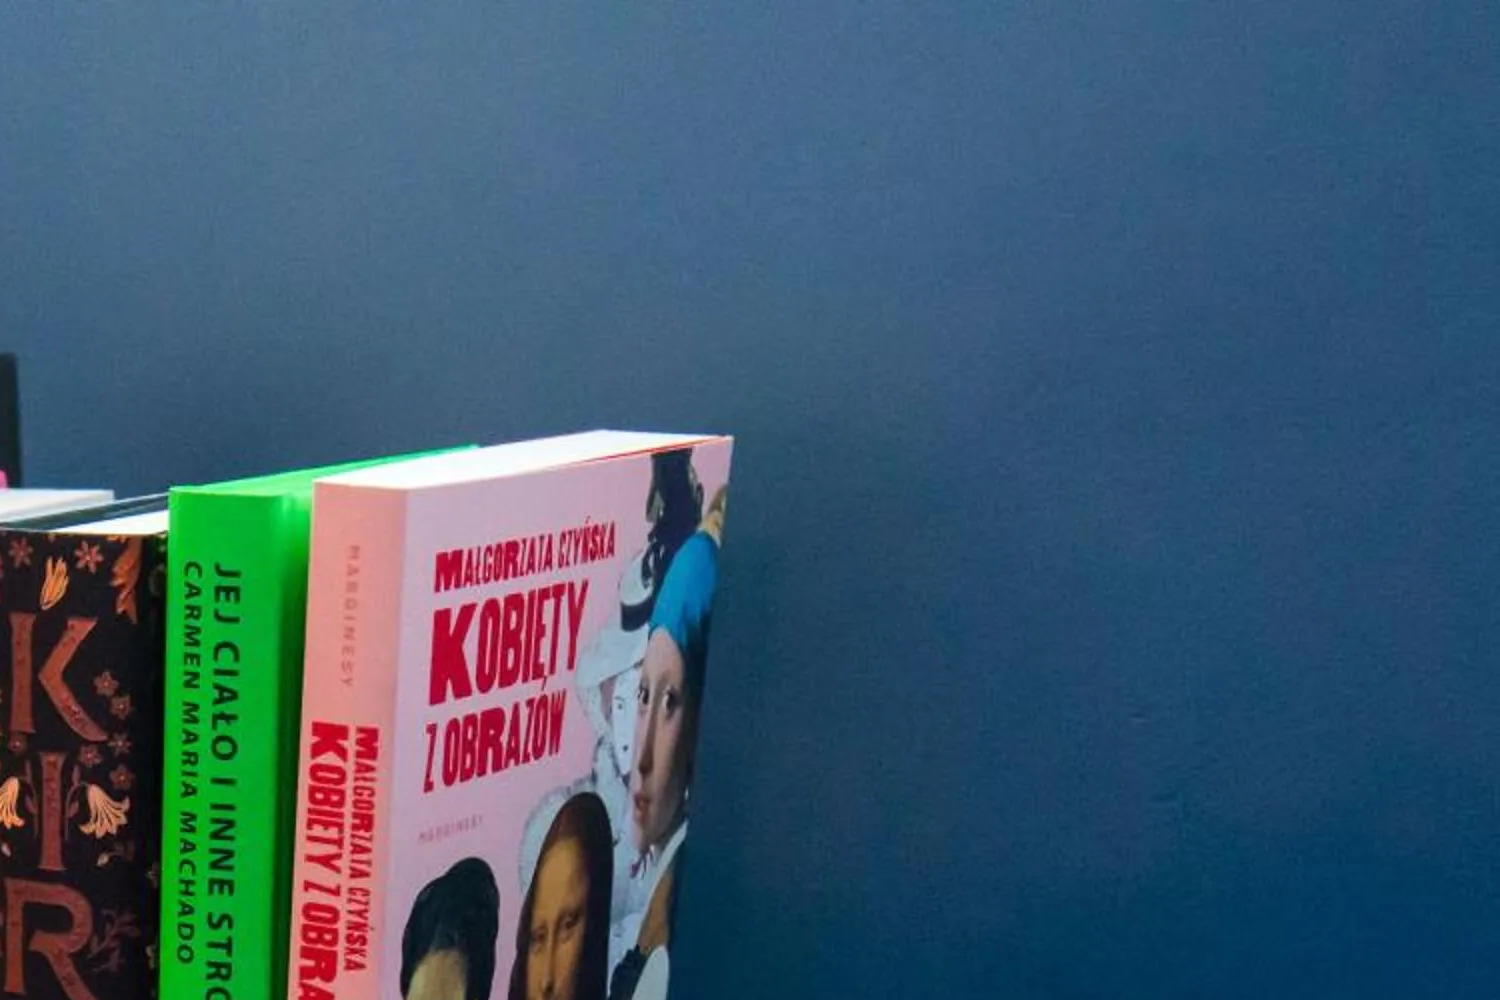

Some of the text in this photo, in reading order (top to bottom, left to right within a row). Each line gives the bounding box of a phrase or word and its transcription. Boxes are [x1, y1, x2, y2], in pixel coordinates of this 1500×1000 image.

[213, 562, 241, 625] JEJ
[434, 515, 615, 593] MAŁGORZATA CZYŃSKA
[210, 640, 240, 761] CIAŁO
[429, 579, 588, 706] KOBIETY
[176, 561, 202, 965] CARMEN MARIA MACHADO
[210, 776, 237, 787] I
[423, 674, 566, 793] Z OBRAZÓW
[207, 803, 236, 897] INNE
[304, 721, 349, 874] KOBIETY
[343, 727, 379, 971] MAŁGORZATA CZYŃSKA
[303, 879, 341, 897] Z
